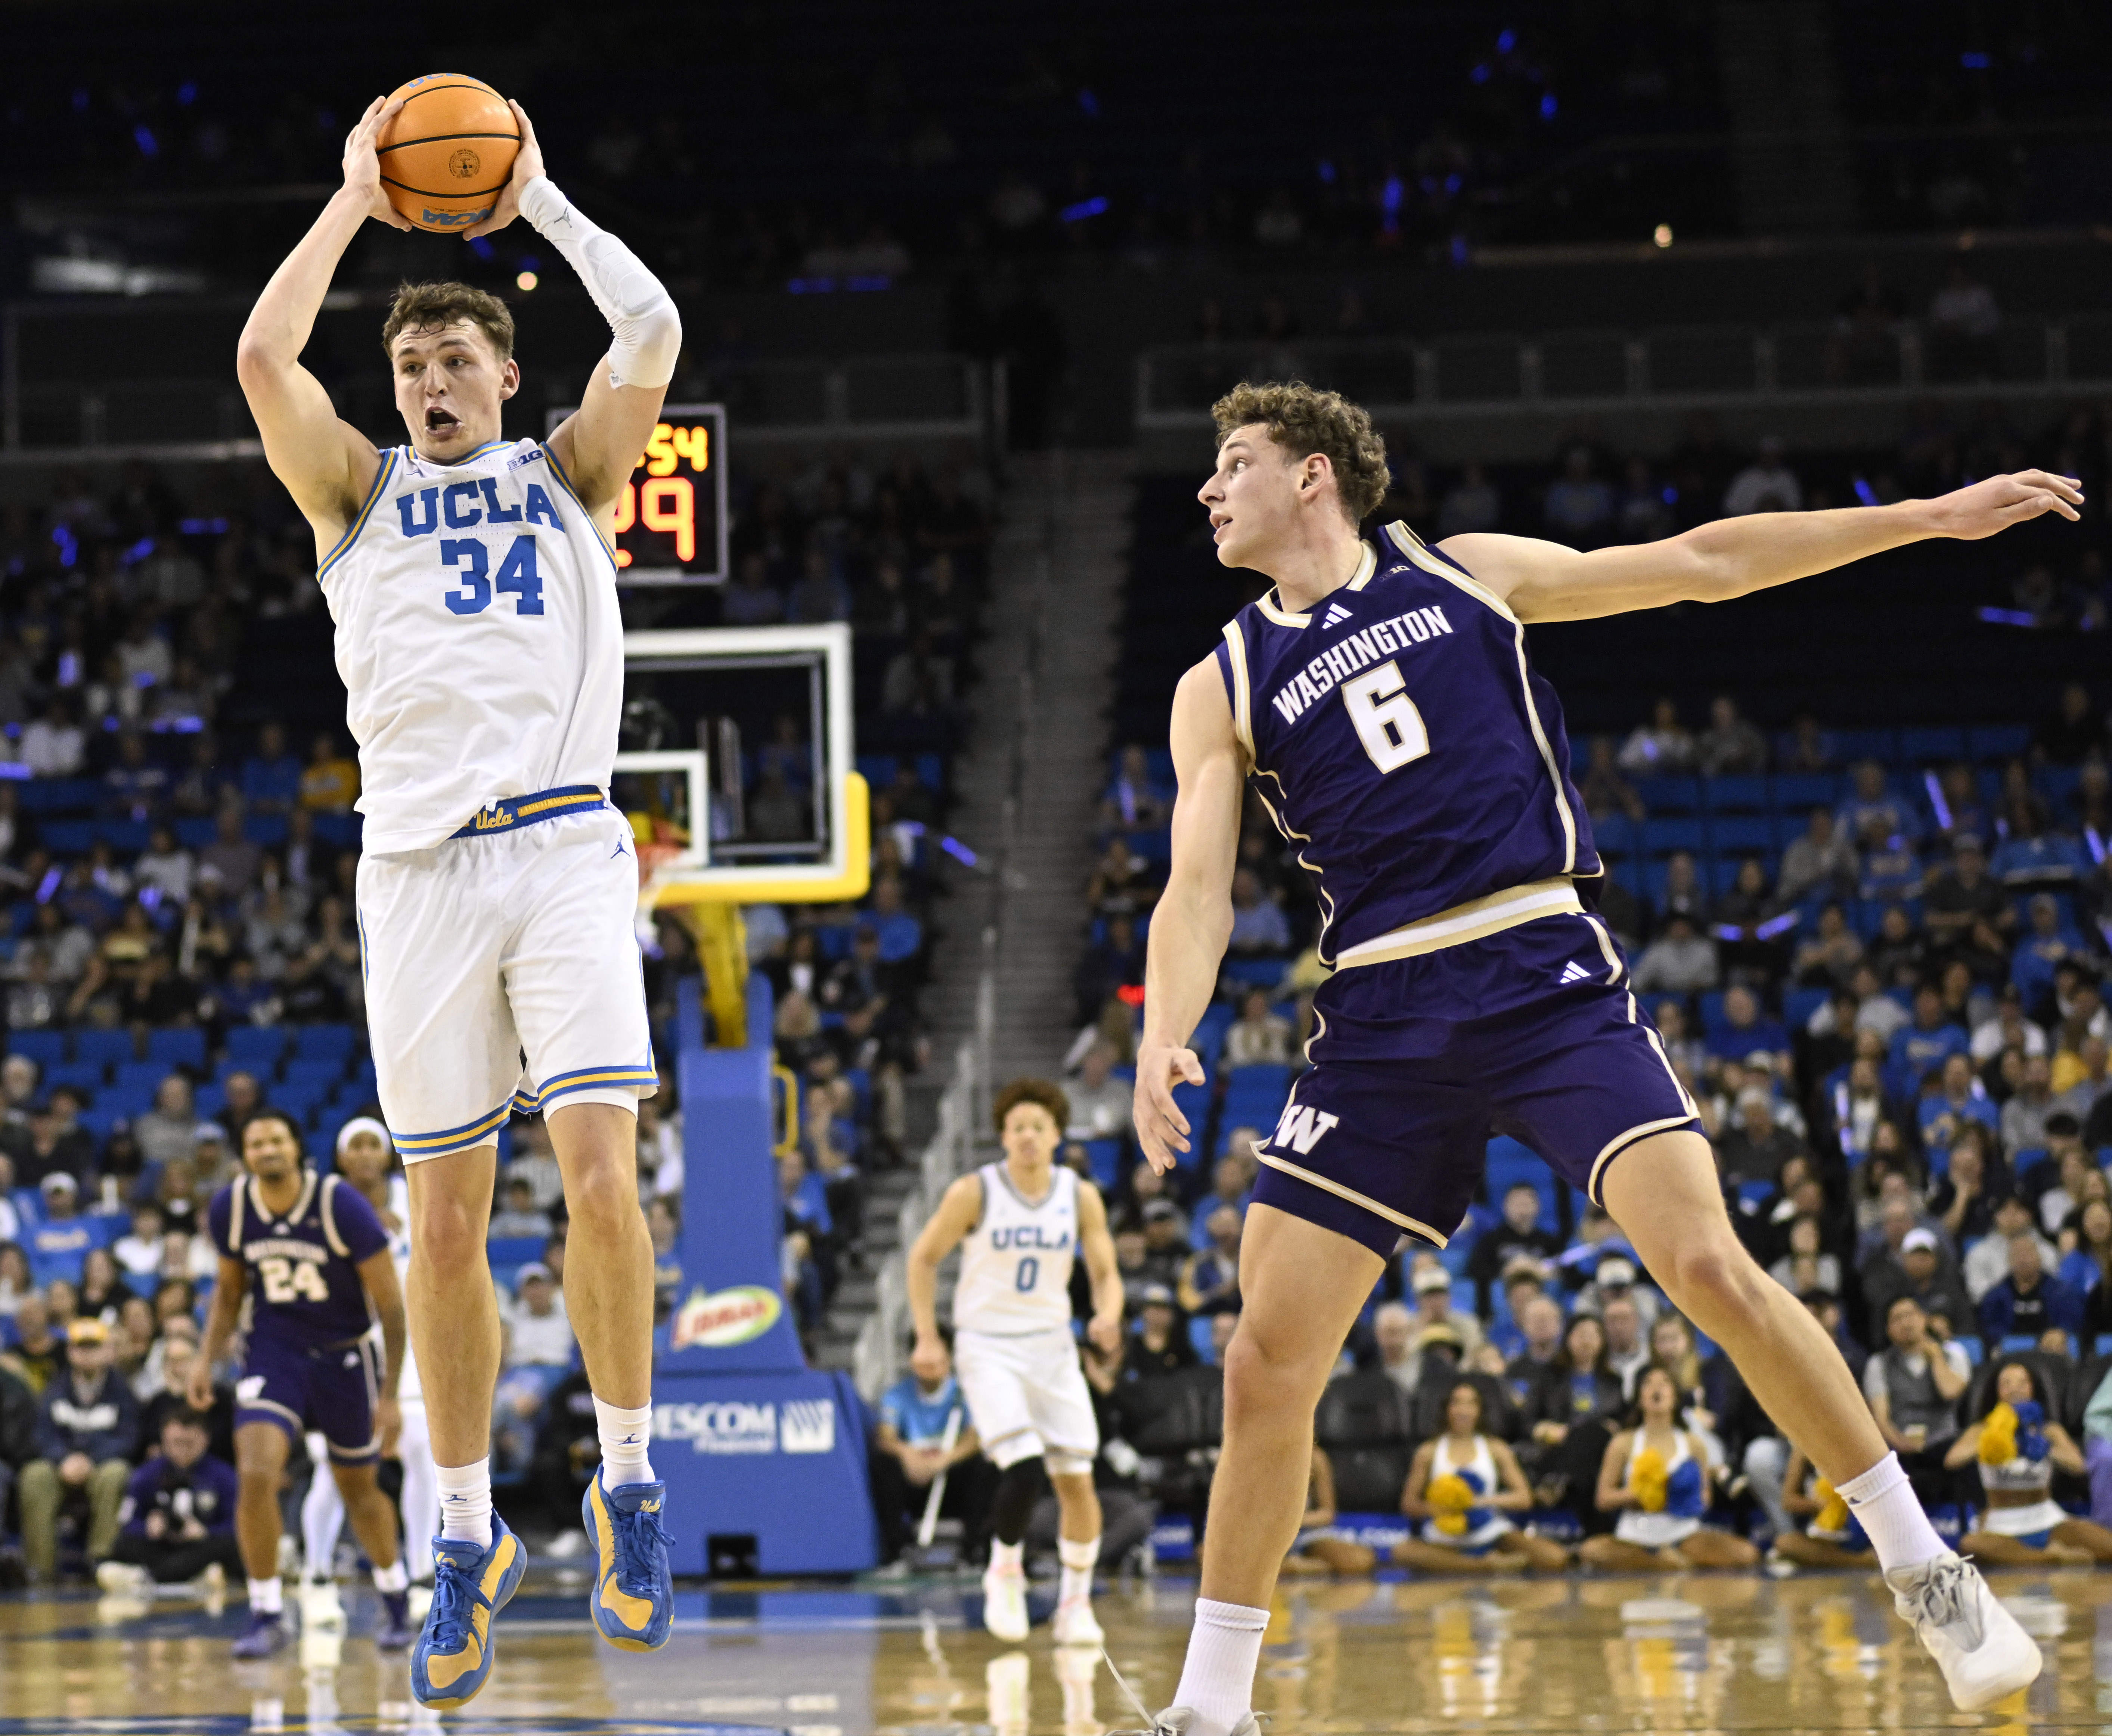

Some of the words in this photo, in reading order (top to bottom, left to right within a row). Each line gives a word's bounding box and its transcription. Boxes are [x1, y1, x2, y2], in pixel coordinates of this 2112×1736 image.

[635, 423, 708, 476] 54
[396, 477, 565, 538] UCLA
[440, 535, 544, 615] 34
[1272, 605, 1454, 725] WASHINGTON
[1341, 659, 1430, 774] 6
[473, 807, 514, 829] Ucla
[1274, 1105, 1340, 1155] W
[257, 1258, 329, 1303] 24
[1016, 1256, 1039, 1292] 0
